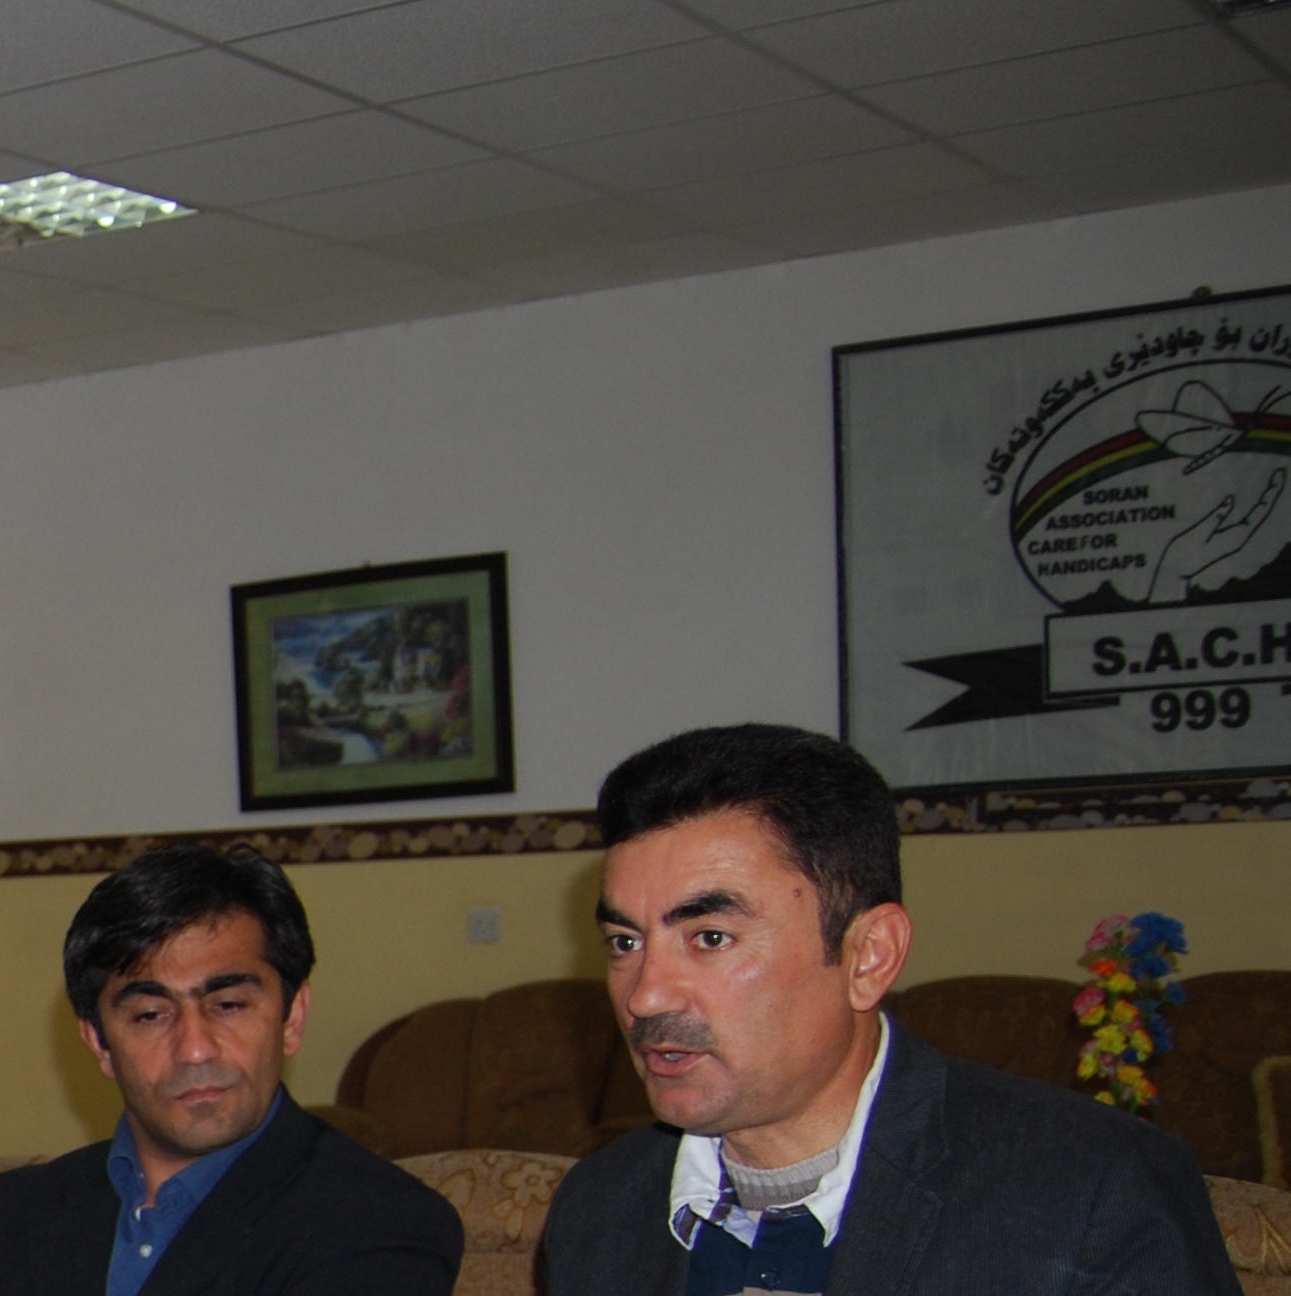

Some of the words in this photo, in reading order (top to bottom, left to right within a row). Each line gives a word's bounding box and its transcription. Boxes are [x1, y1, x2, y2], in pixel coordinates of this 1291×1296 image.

[1083, 485, 1149, 505] SORAN
[1045, 505, 1175, 531] ASSOCIATION
[1038, 553, 1146, 577] HANDICAPS
[1151, 688, 1251, 733] 999
